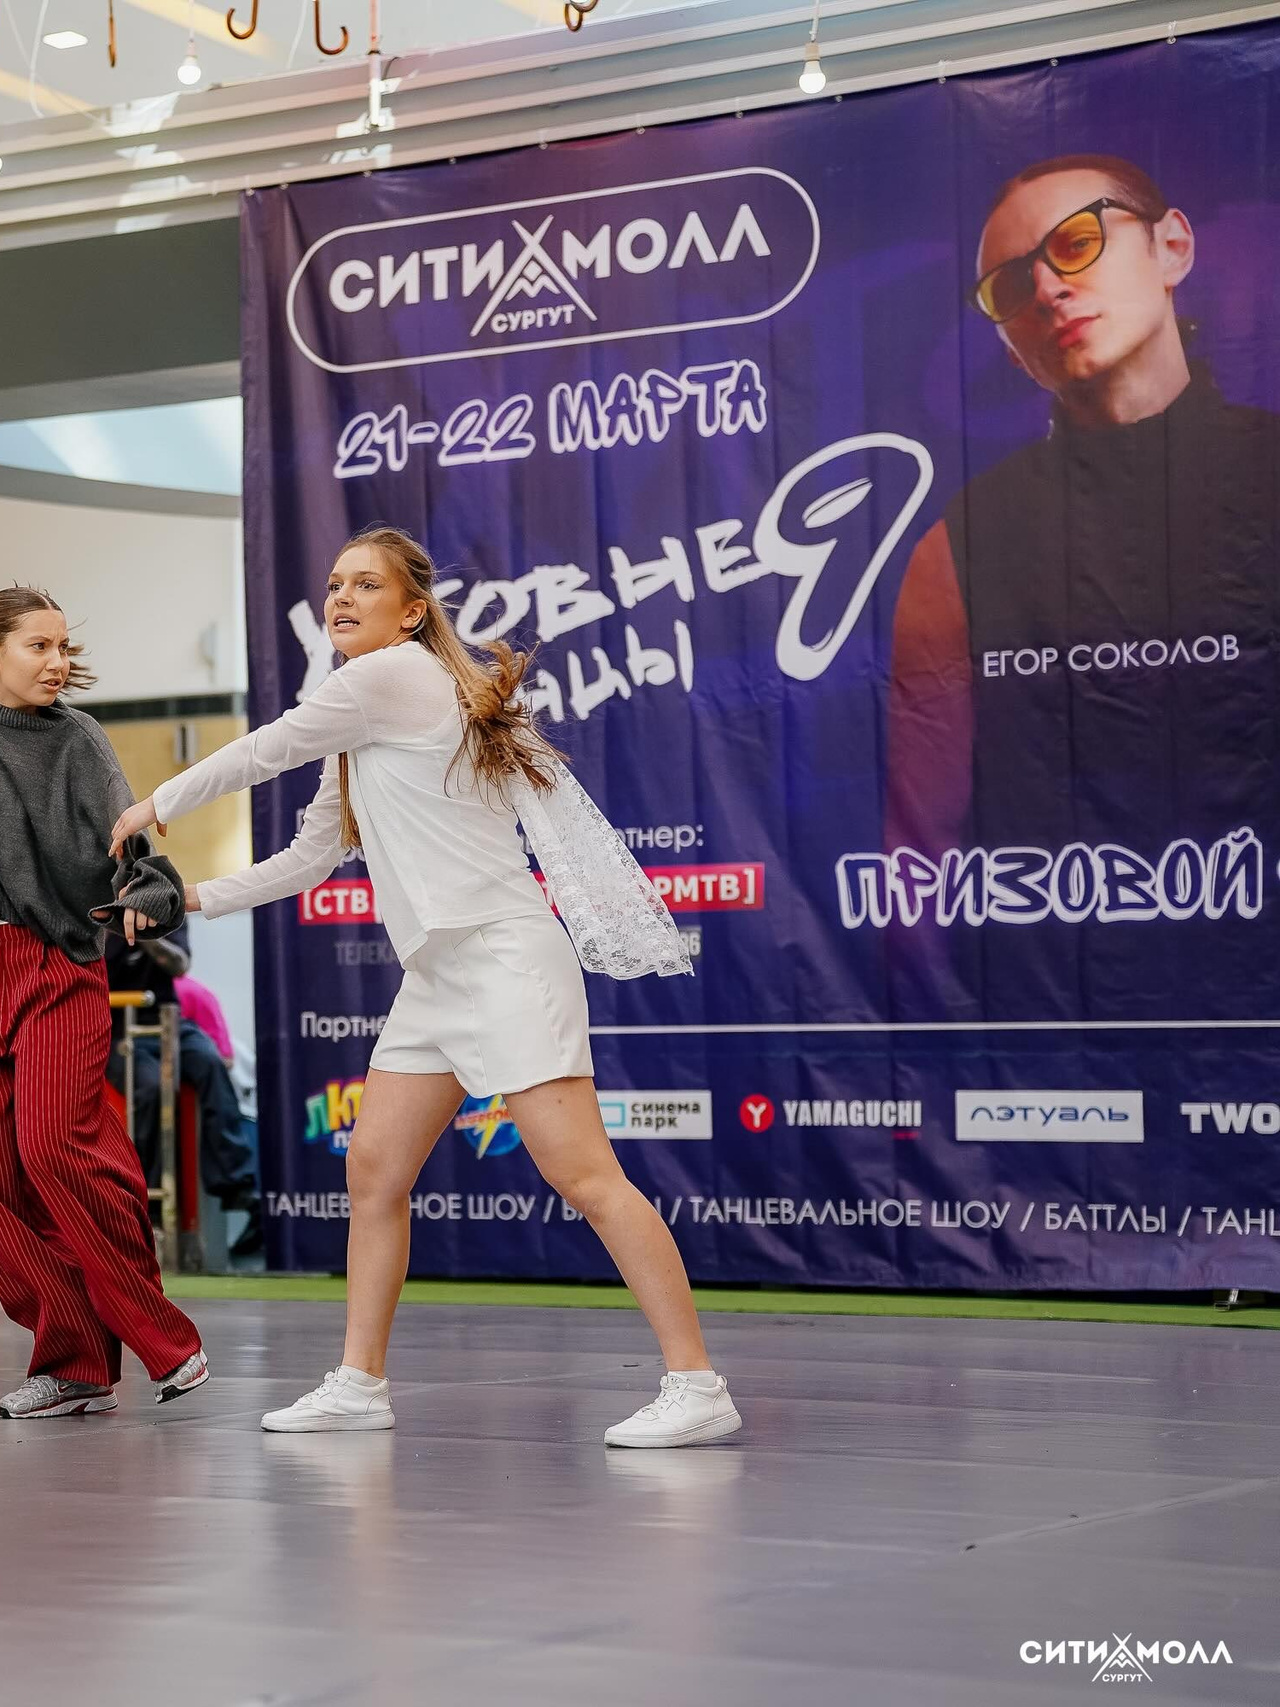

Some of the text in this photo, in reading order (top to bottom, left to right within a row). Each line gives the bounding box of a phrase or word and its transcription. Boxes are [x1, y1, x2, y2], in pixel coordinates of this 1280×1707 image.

[329, 203, 771, 313] СИТИ МОЛЛ
[490, 304, 576, 334] СУРГУТ
[333, 359, 767, 479] 21-22 МАРТА
[983, 634, 1240, 678] ЕГОР СОКОЛОВ
[835, 826, 1263, 930] ПРИЗОВОЙ
[301, 1011, 388, 1043] Партне
[631, 1115, 678, 1133] парк
[783, 1100, 922, 1128] YAMAGUCHI
[266, 1192, 462, 1221] ТАНЦЕВНОЕ
[468, 1192, 536, 1221] ШОУ
[689, 1197, 922, 1227] ТАНЦЕВАЛЬНОЕ
[931, 1200, 1011, 1230] ШОУ
[1044, 1202, 1166, 1234] БАТТЛЫ
